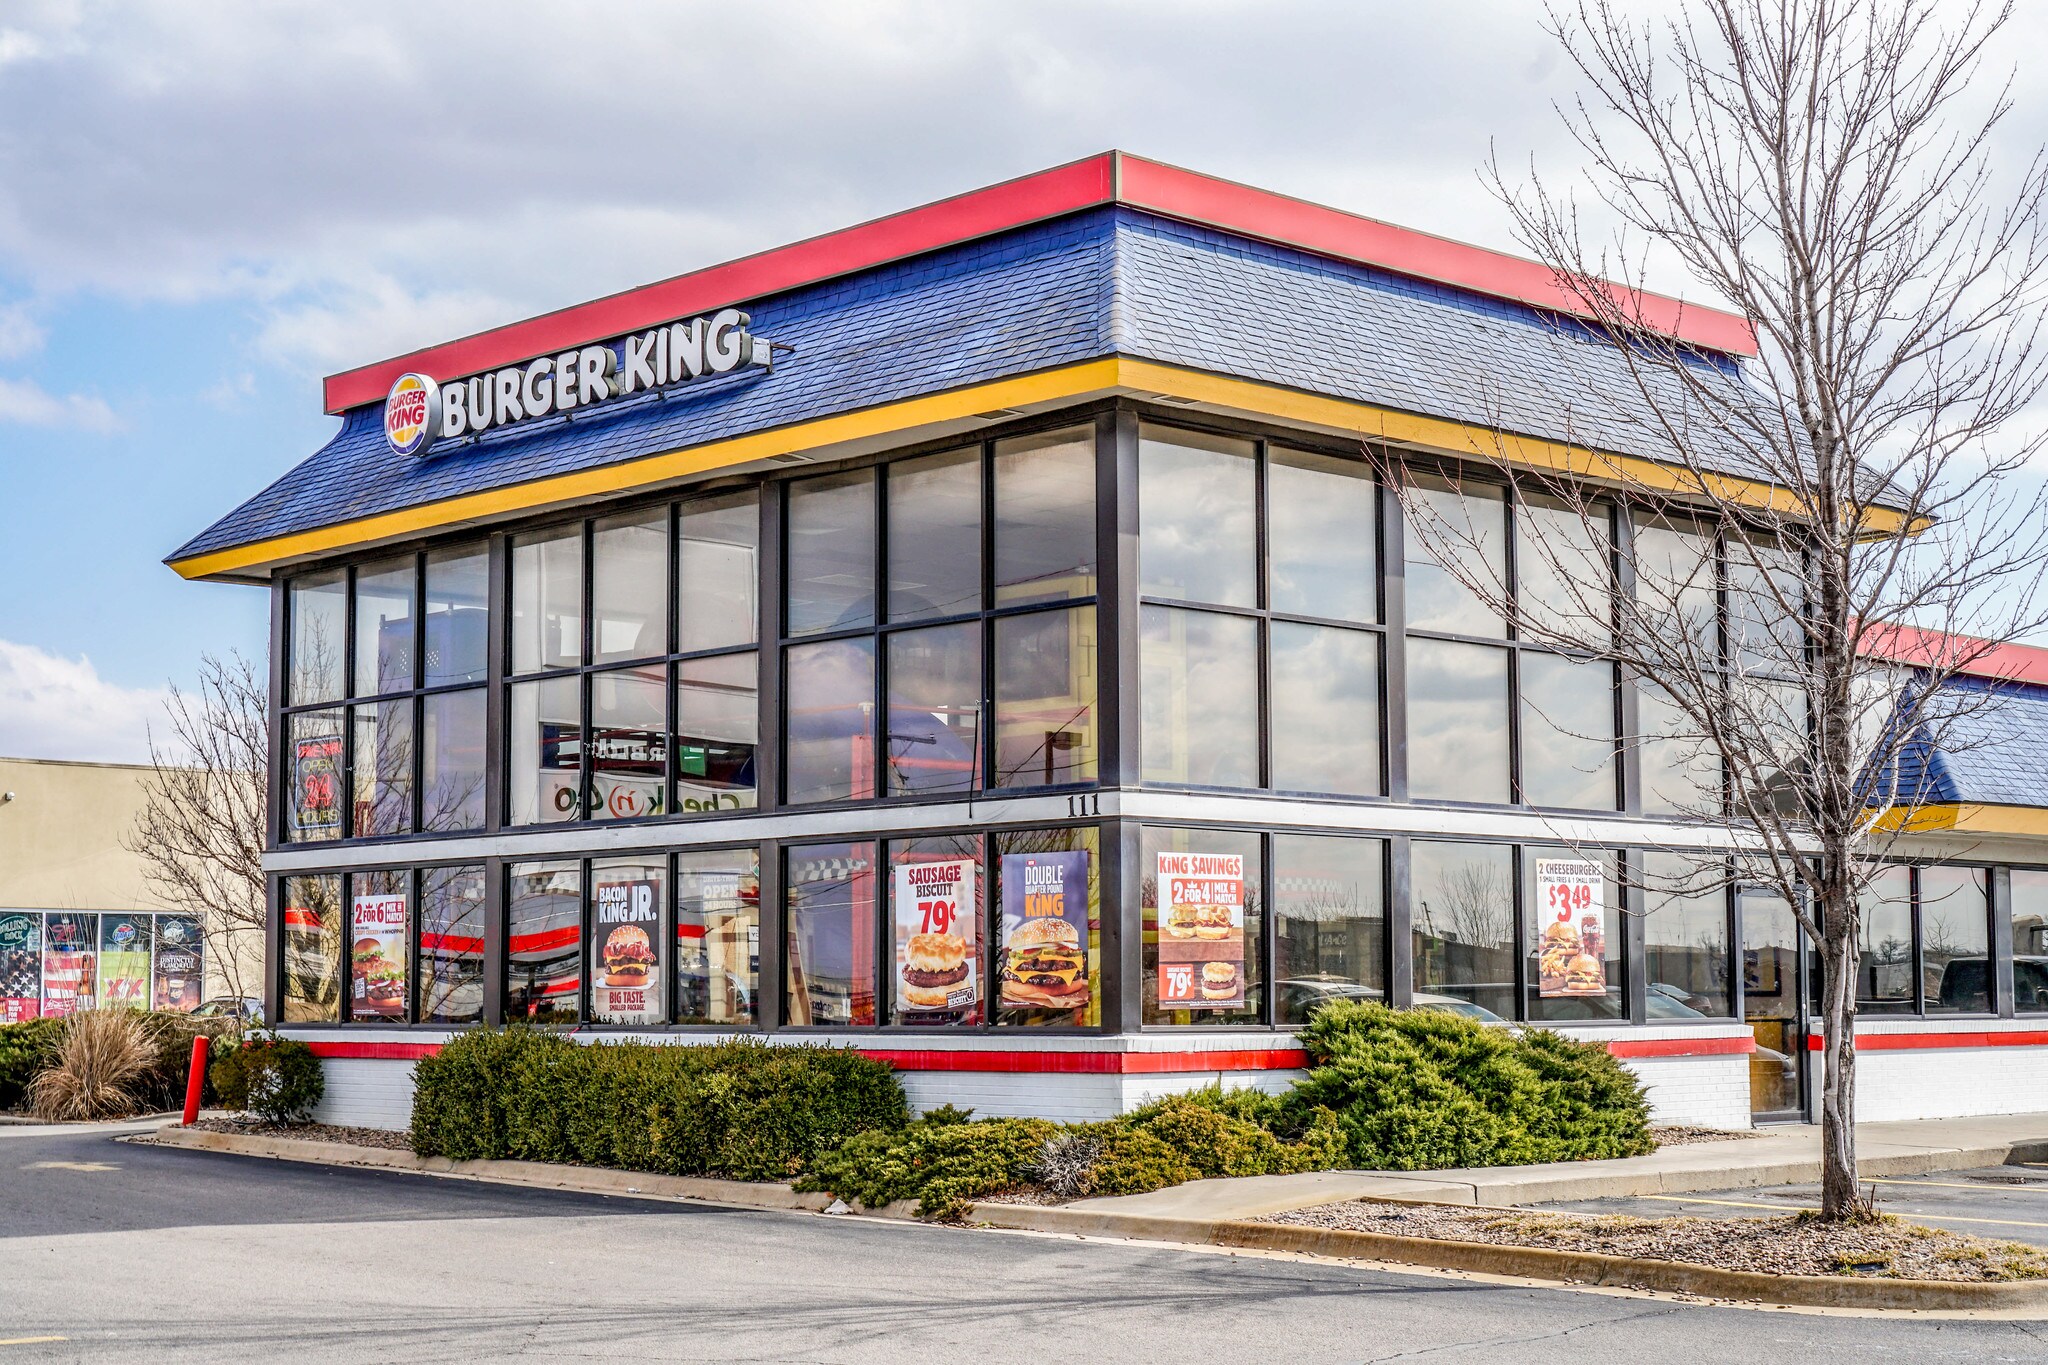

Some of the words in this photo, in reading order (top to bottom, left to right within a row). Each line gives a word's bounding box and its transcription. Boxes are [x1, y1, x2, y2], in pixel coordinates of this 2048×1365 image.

[442, 346, 614, 438] BURGER
[625, 309, 750, 391] KING
[388, 391, 426, 413] BURGER
[388, 405, 425, 433] KING
[303, 759, 333, 772] OPEN
[305, 774, 332, 808] 24
[1068, 793, 1101, 817] 111
[297, 810, 338, 823] HOURS
[908, 865, 961, 885] SAUSAGE
[1025, 865, 1064, 885] DOUBLE
[1539, 863, 1544, 874] 2
[1546, 863, 1601, 876] CHEESEBURGERS
[599, 886, 627, 902] BACON
[703, 884, 738, 898] OPEN
[916, 883, 953, 897] BISCUIT
[1047, 884, 1063, 893] POUND
[1174, 881, 1184, 903] 2
[1184, 889, 1201, 902] FOR
[1214, 882, 1228, 893] MIX
[630, 885, 657, 922] JR.
[711, 900, 737, 909] HOURS
[1214, 893, 1237, 903] MATCH
[355, 903, 362, 924] 2
[363, 909, 376, 922] FOR
[609, 991, 621, 1004] BIG
[623, 991, 645, 1003] TASTE.
